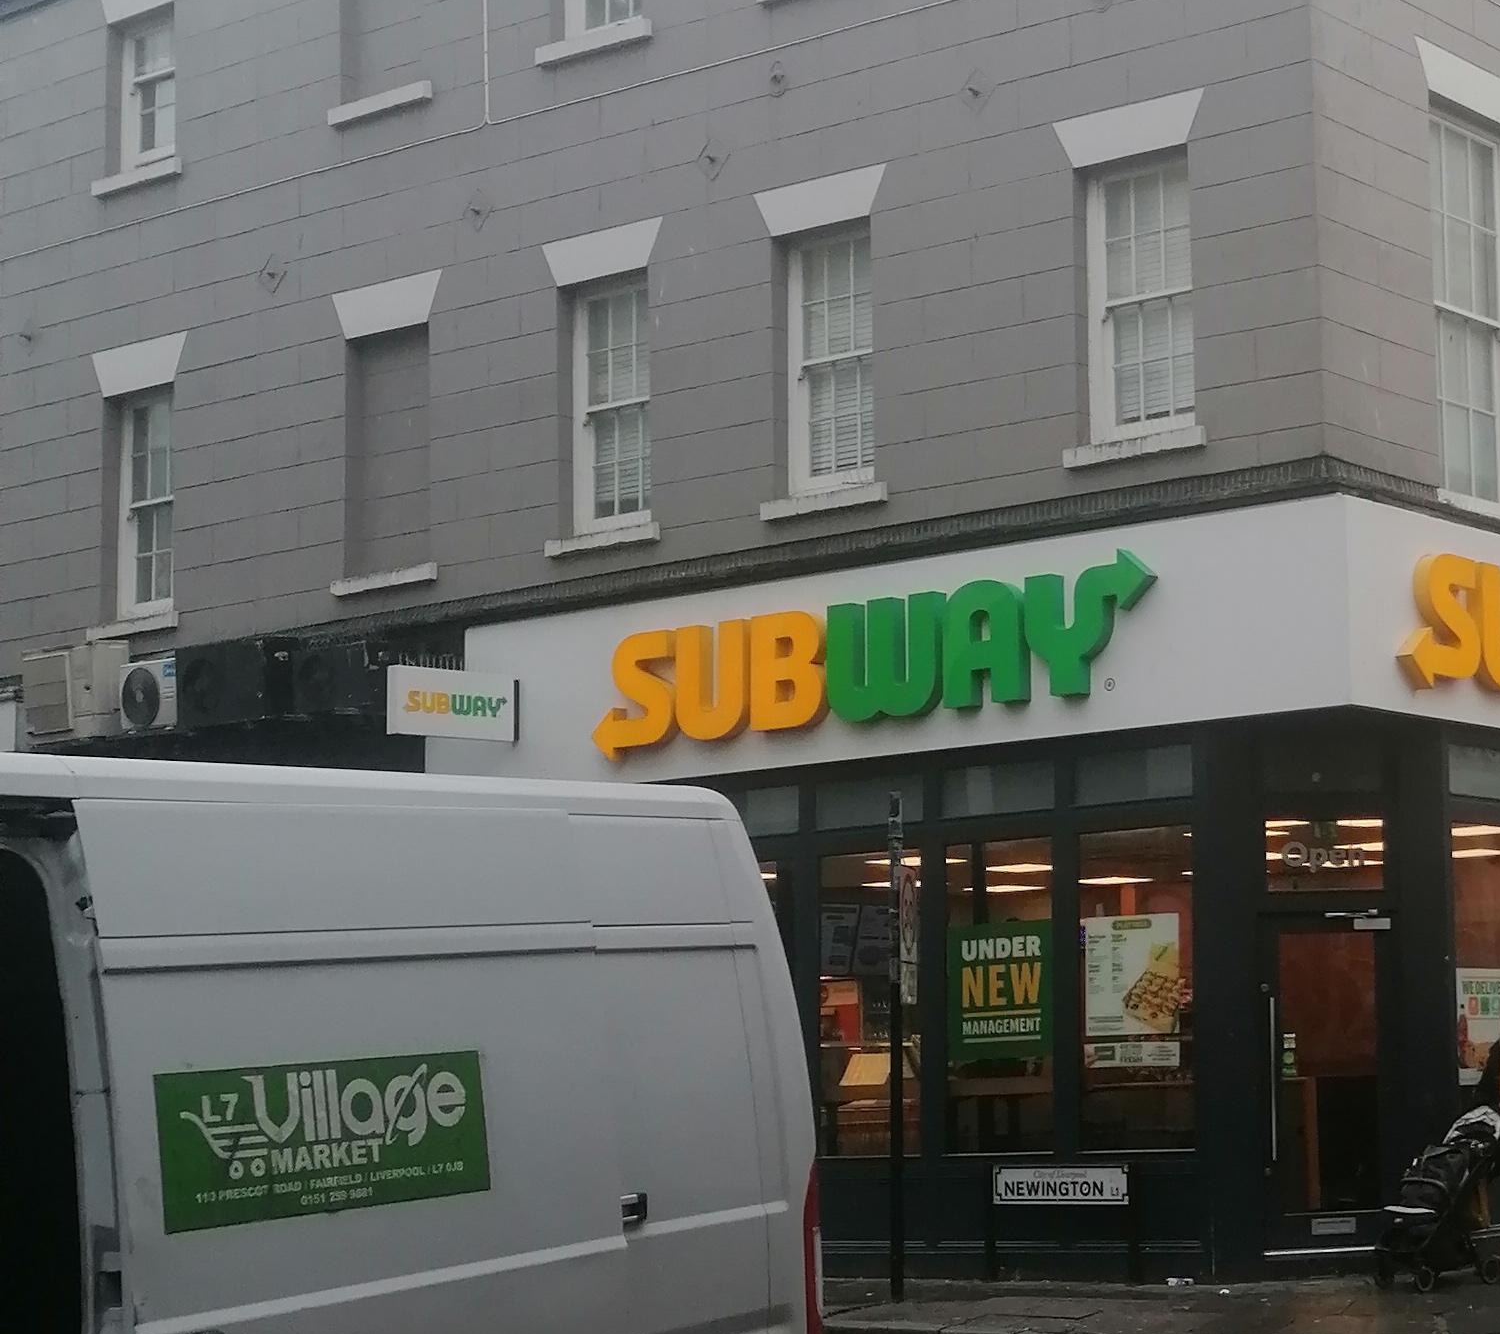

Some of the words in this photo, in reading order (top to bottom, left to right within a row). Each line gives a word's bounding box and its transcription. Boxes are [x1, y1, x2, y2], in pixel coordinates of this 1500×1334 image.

[591, 548, 1158, 761] SUBWAY
[402, 689, 508, 719] SUBWAY
[1281, 841, 1365, 874] Open
[961, 934, 1042, 962] UNDER
[961, 962, 1042, 1009] NEW
[961, 1017, 1042, 1036] MANAGEMENT
[201, 1092, 240, 1123] L7
[240, 1062, 467, 1147] Village
[270, 1137, 385, 1177] MARKET
[308, 1172, 363, 1190] FAIRFIELD
[369, 1165, 425, 1183] LIVERPOOL
[1003, 1180, 1104, 1197] NEWINGTON
